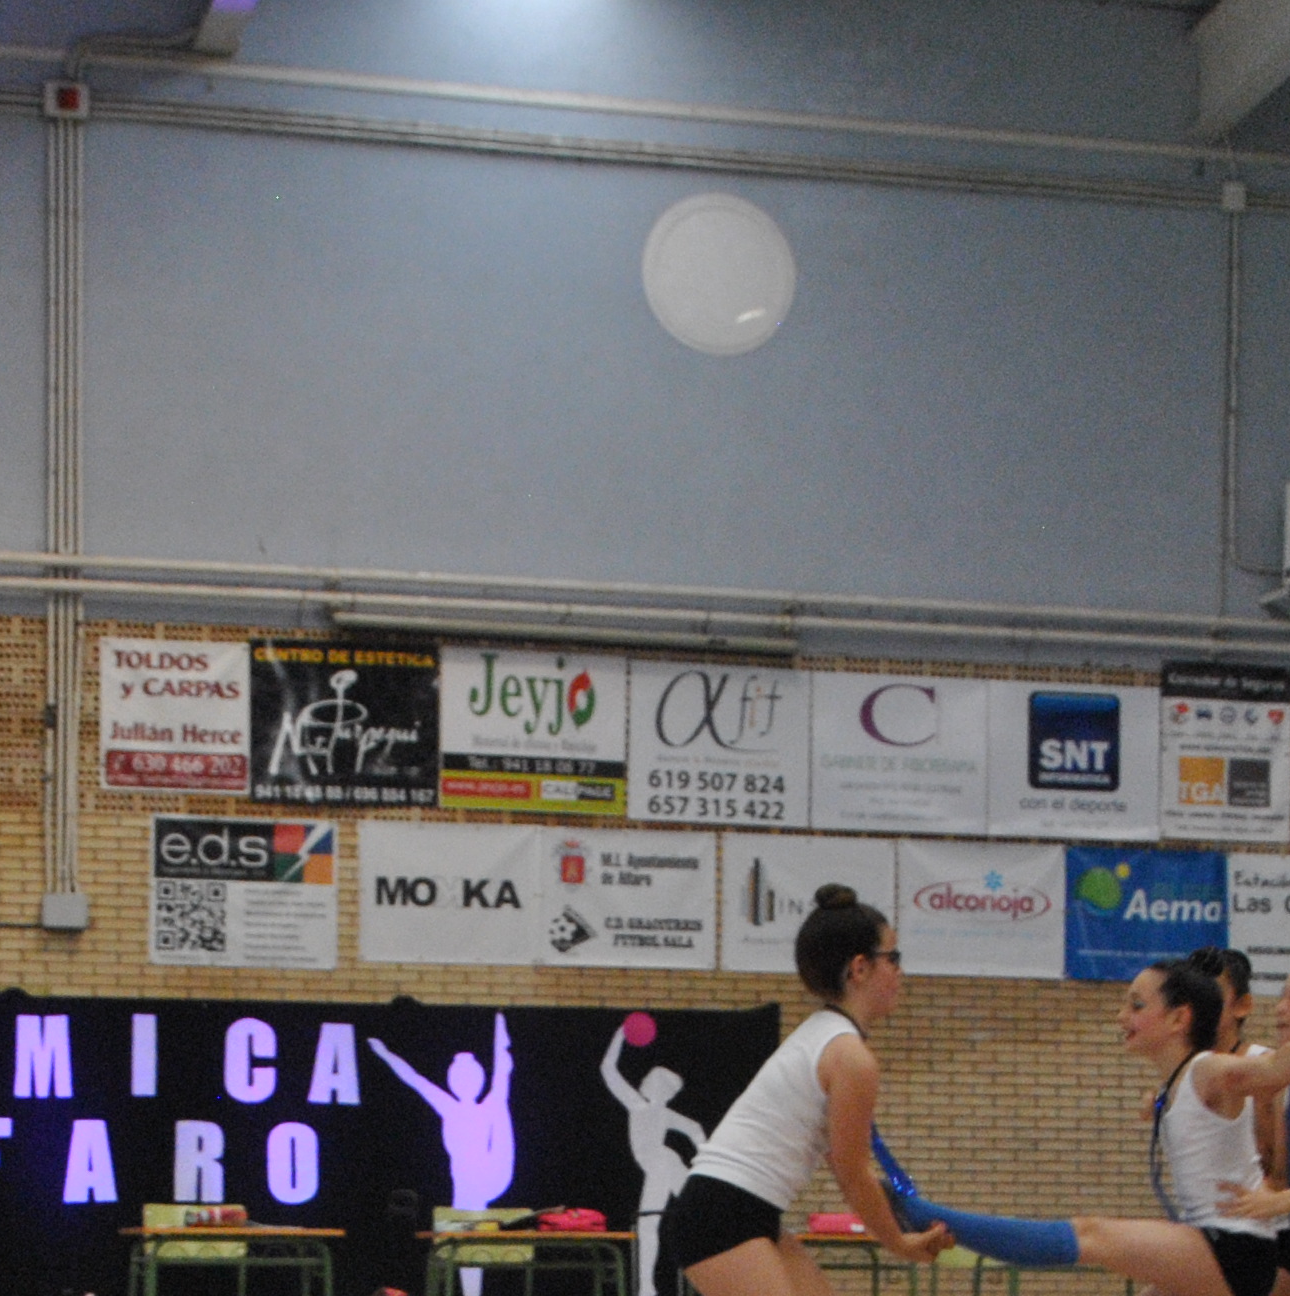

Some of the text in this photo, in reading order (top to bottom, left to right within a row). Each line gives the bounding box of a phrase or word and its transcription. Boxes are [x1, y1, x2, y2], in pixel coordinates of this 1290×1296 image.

[113, 649, 209, 672] TOLDOS
[253, 647, 324, 664] CENTRO
[327, 649, 350, 665] DE
[121, 678, 241, 699] y CARPAS
[468, 652, 597, 737] Jeyjo
[859, 682, 936, 748] C
[181, 723, 243, 746] Herce
[1039, 738, 1109, 771] SNT
[648, 769, 785, 794] 619 507 824
[648, 795, 785, 820] 657 315 422
[1019, 797, 1128, 816] con el deporte
[160, 826, 269, 868] e.d.s
[375, 875, 522, 909] MO KA
[928, 882, 1035, 922] alconoja
[1232, 892, 1272, 914] Las
[1122, 887, 1222, 923] Aema
[663, 935, 694, 949] SALA
